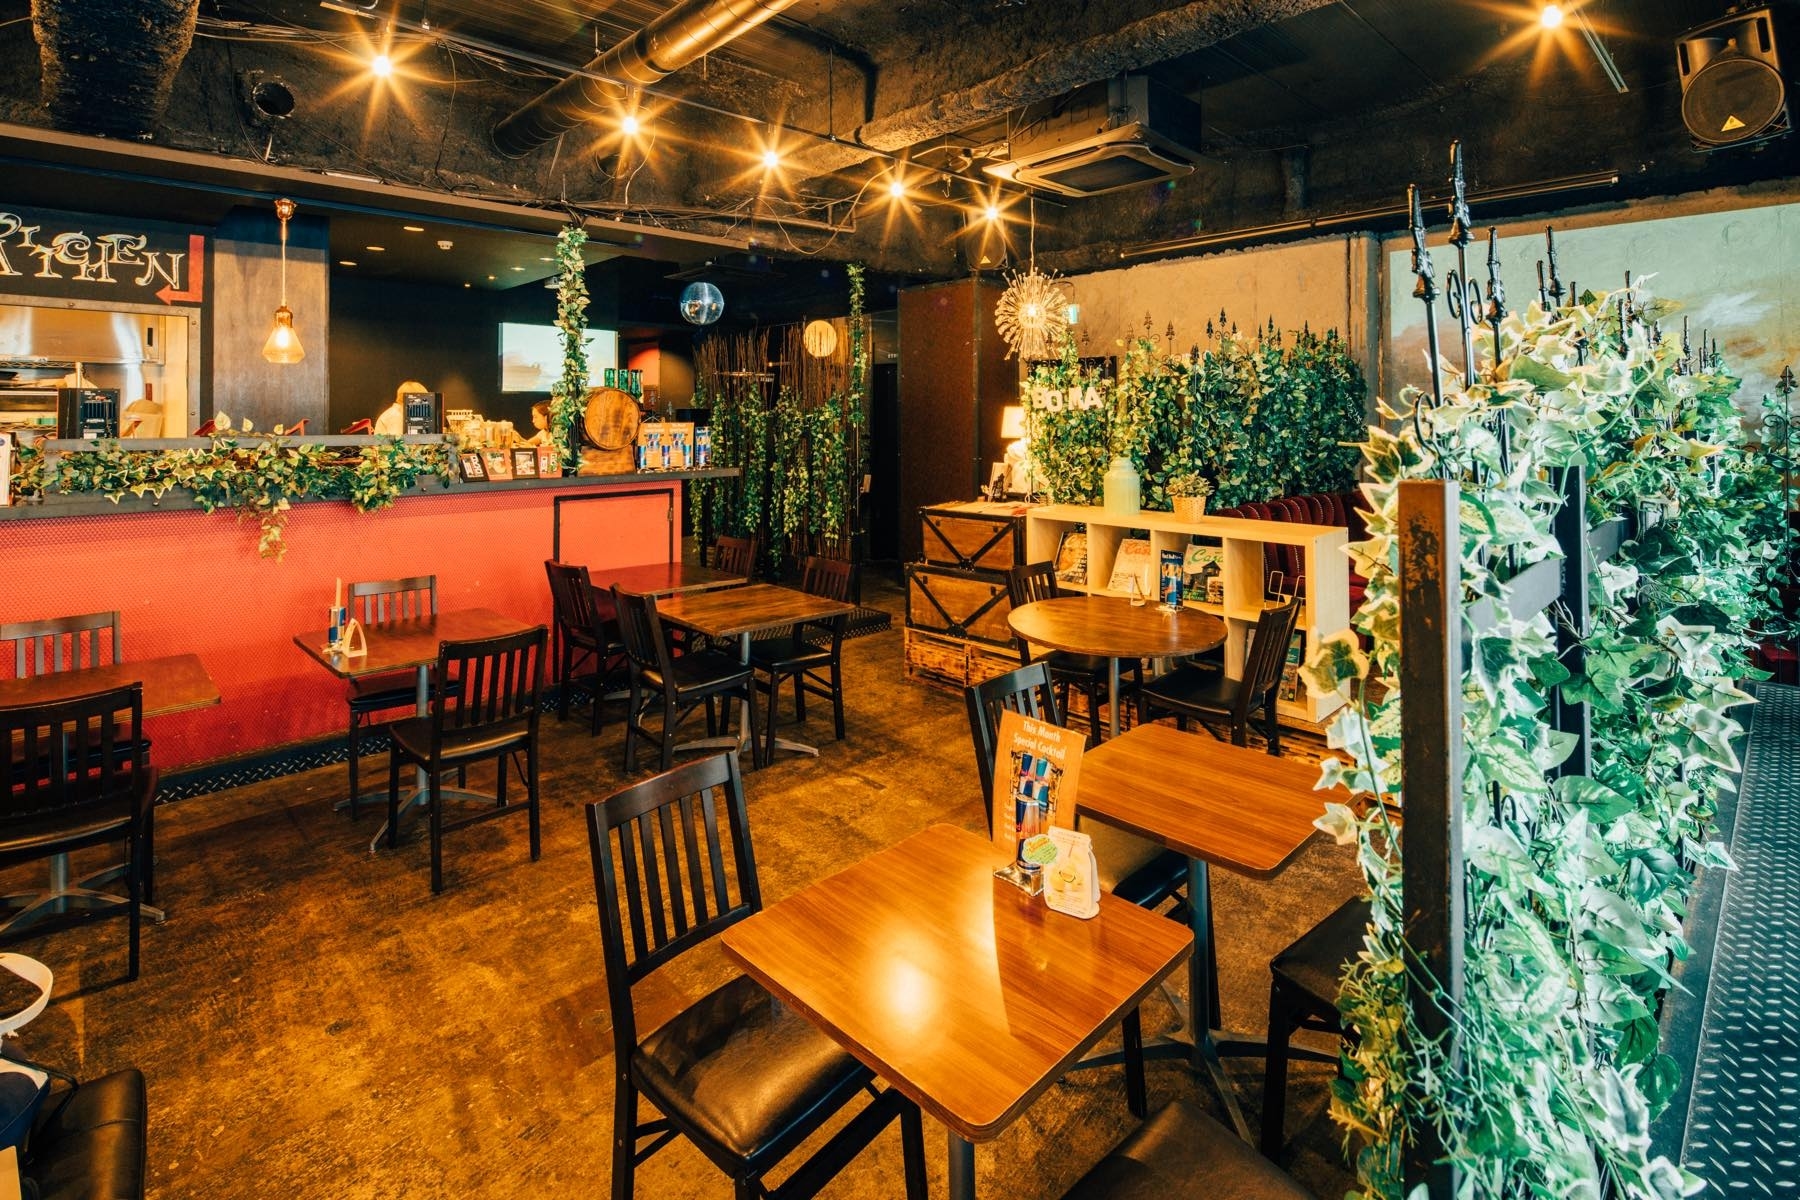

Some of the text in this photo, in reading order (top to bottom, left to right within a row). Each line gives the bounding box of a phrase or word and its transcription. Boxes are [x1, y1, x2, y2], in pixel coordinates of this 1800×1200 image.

[1024, 720, 1061, 743] This Month
[1013, 732, 1067, 760] Special Cocktail
